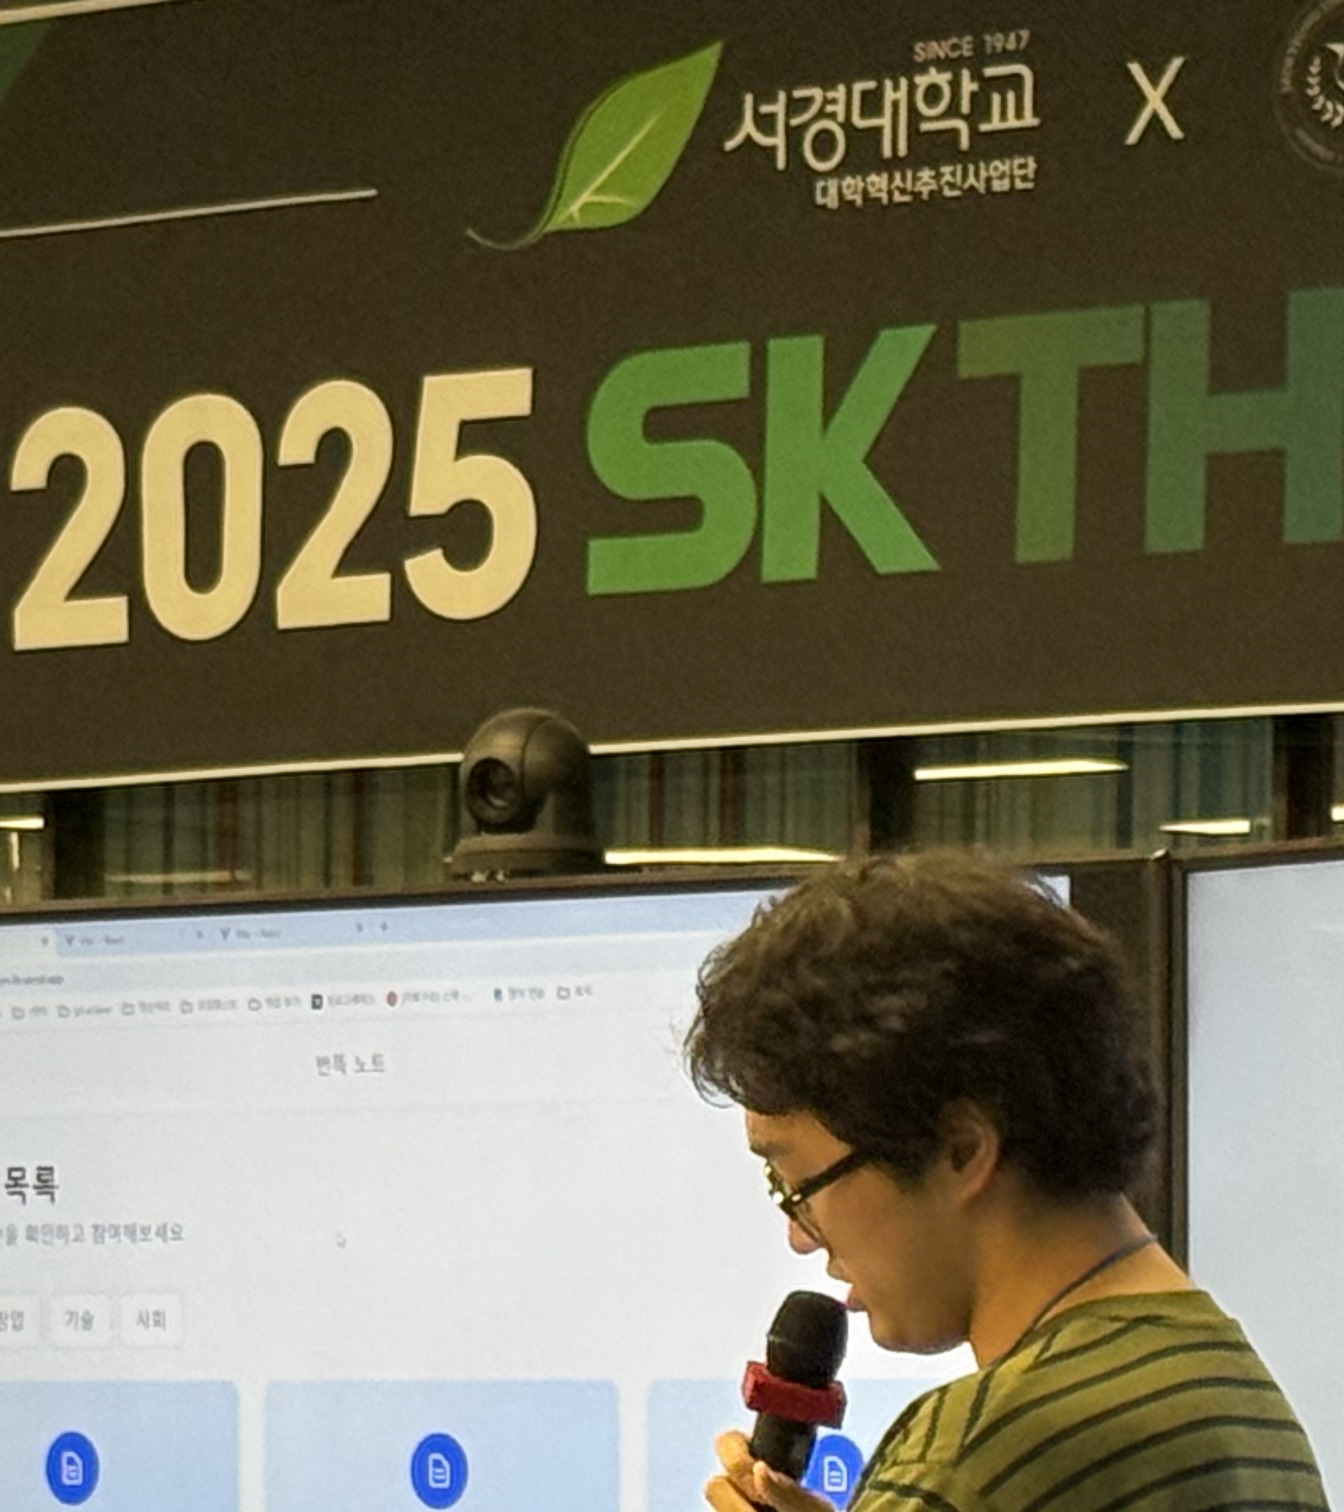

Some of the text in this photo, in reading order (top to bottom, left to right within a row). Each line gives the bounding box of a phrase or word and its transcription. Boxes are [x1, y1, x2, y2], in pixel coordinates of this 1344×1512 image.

[913, 29, 1030, 63] SINCE 1947
[724, 64, 1041, 172] 서경대학교
[1125, 55, 1187, 148] X
[815, 155, 1038, 209] 대학혁신추진사업단
[9, 366, 539, 652] 2025
[316, 1054, 386, 1076] 번뜩 노트
[5, 1165, 59, 1204] 목록
[64, 1310, 95, 1331] 기술
[136, 1309, 167, 1330] 사회
